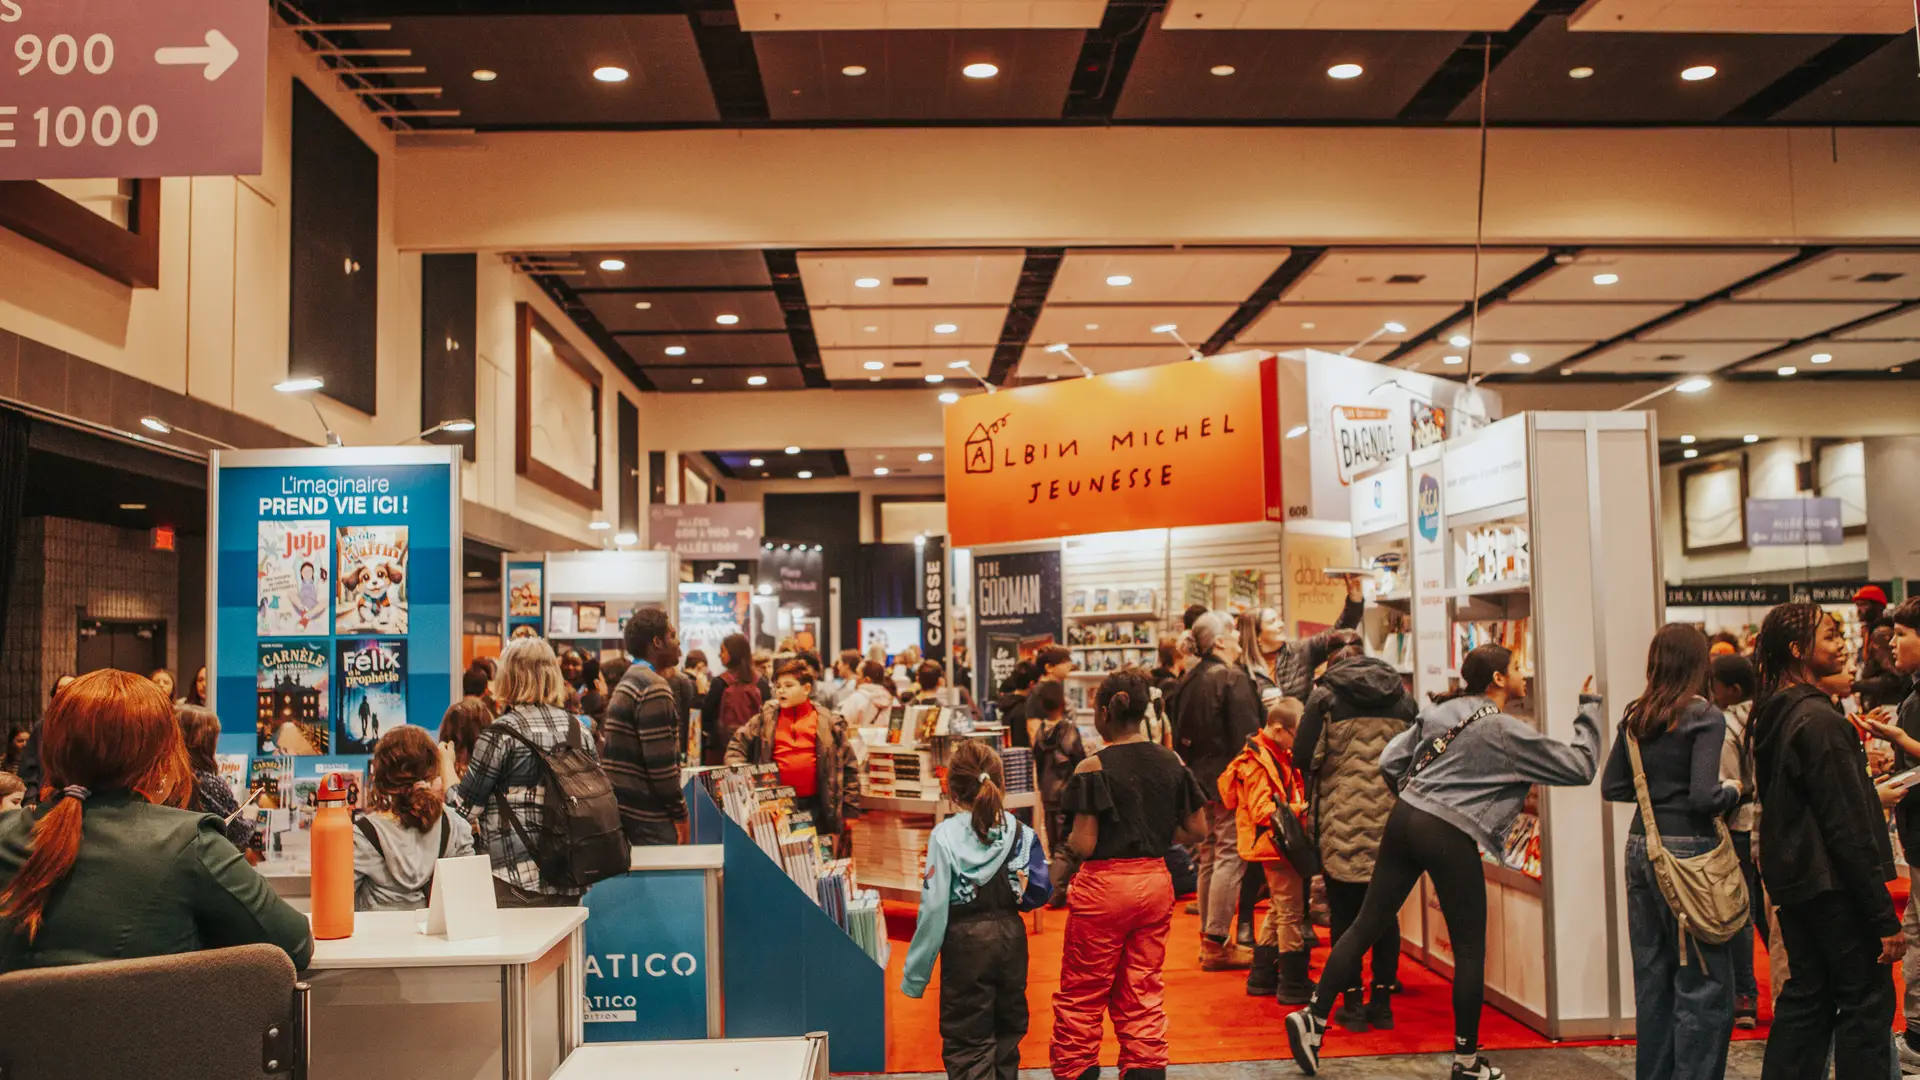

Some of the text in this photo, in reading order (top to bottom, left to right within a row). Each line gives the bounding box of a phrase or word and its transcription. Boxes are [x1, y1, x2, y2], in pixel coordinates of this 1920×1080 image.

[14, 33, 115, 76] 900
[33, 104, 158, 148] 1000
[1111, 414, 1235, 451] MICHEL
[1340, 424, 1395, 468] BAGNOLE
[281, 475, 390, 497] L'imaginaire
[1028, 464, 1173, 504] JEUNESSE
[258, 497, 329, 516] PREND
[334, 497, 367, 515] VIE
[373, 496, 398, 514] ICI
[1288, 506, 1309, 517] 608
[283, 530, 326, 559] Juju
[926, 560, 942, 646] CAISSE
[979, 574, 1040, 616] GORMAN
[262, 647, 326, 668] CARNÈLE
[343, 648, 401, 672] Félix
[345, 671, 399, 688] prophétie
